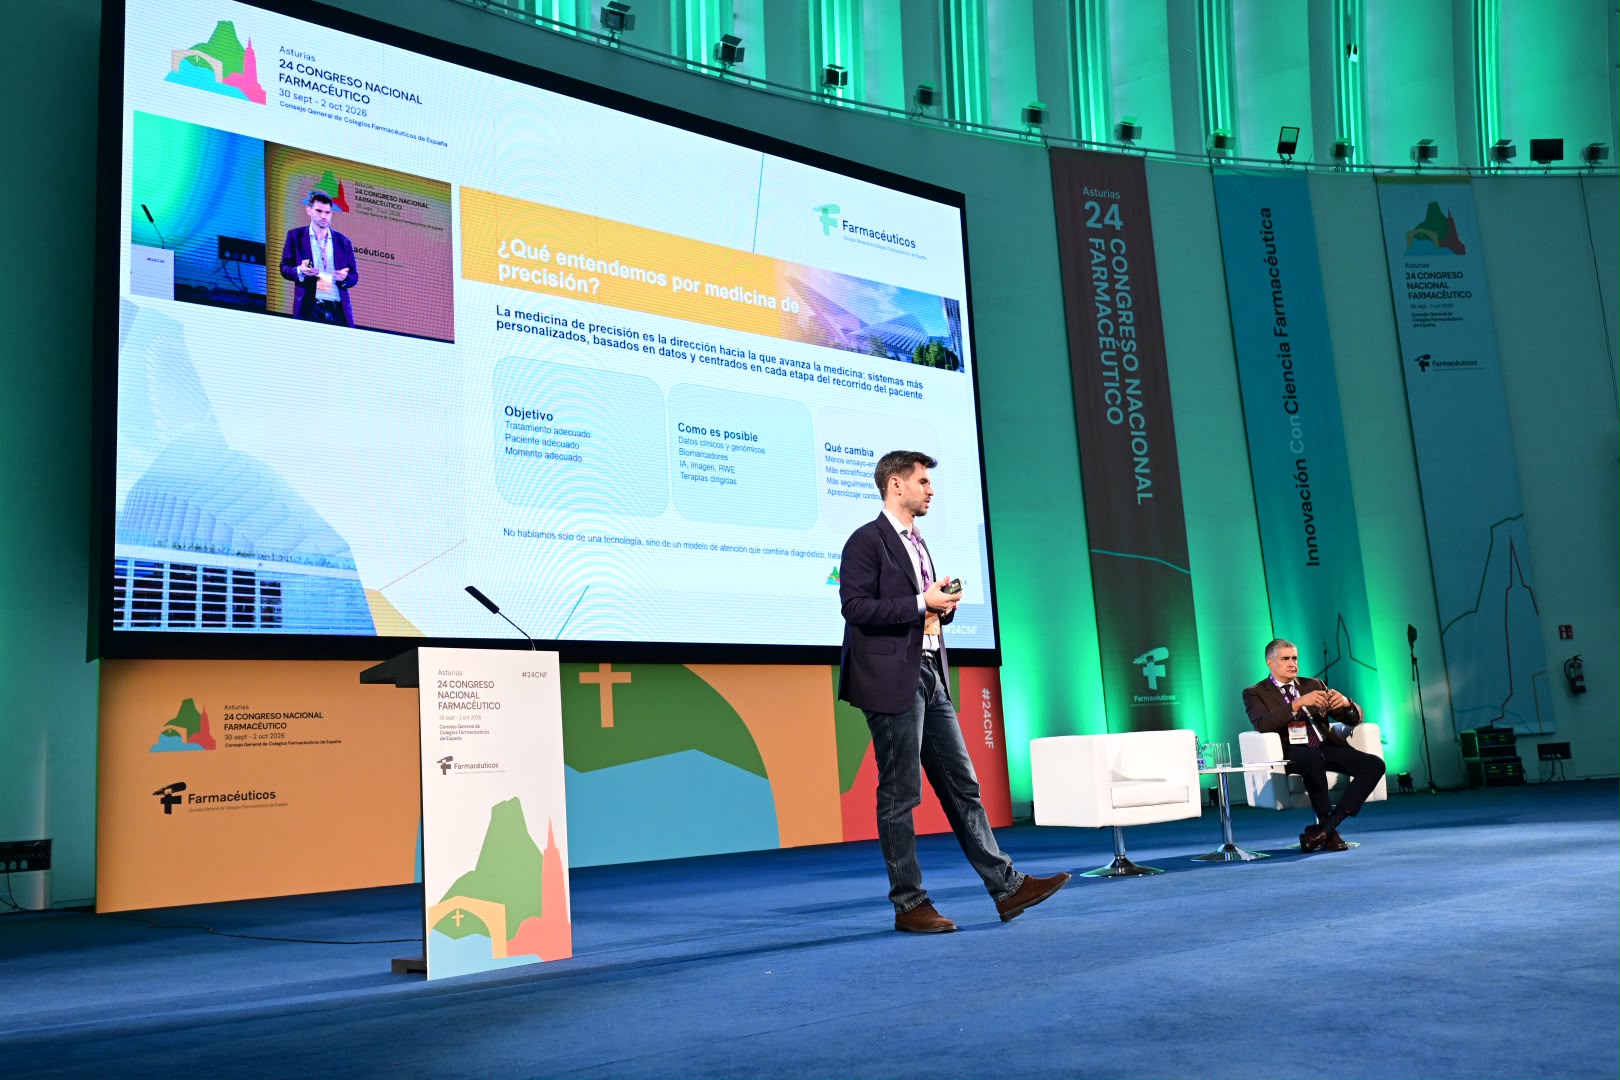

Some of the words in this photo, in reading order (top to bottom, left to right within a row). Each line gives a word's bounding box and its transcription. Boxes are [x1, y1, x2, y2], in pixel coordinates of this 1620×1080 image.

[280, 46, 316, 62] Asturias
[280, 59, 294, 70] 24
[296, 64, 362, 88] CONGRESO
[366, 82, 422, 104] NACIONAL
[280, 73, 370, 104] FARMACÉUTICO
[279, 88, 290, 98] 30
[294, 94, 312, 104] sept
[321, 98, 326, 108] 2
[328, 102, 342, 112] oct
[346, 105, 368, 117] 2026
[280, 101, 306, 112] Consejo
[308, 108, 333, 118] General
[344, 117, 371, 128] Colegios
[372, 124, 416, 140] Farmacéuticos
[426, 137, 448, 148] España
[364, 190, 398, 202] CONGRESO
[398, 197, 430, 209] NACIONAL
[1083, 186, 1120, 200] Asturias
[842, 220, 916, 249] Farmacéuticos
[353, 246, 396, 260] acéuticos
[498, 238, 551, 262] ¿Qué
[556, 252, 668, 287] entendemos
[672, 276, 700, 293] por
[706, 283, 776, 310] medicina
[781, 296, 800, 314] de
[499, 262, 600, 295] precisión?
[1260, 207, 1288, 338] Farmacéutica
[1406, 272, 1416, 280] 24
[1417, 272, 1464, 280] CONGRESO
[1407, 282, 1450, 290] NACIONAL
[1408, 290, 1472, 300] FARMACÉUTICO
[1089, 238, 1124, 425] FARMACÉUTICO
[496, 304, 511, 318] La
[514, 310, 568, 327] medicina
[572, 319, 585, 330] de
[589, 323, 640, 340] precisión
[642, 332, 655, 342] es
[658, 334, 666, 344] la
[670, 336, 716, 353] dirección
[720, 345, 746, 358] hacia
[748, 350, 756, 360] la
[760, 354, 776, 364] que
[780, 357, 811, 370] avanza
[814, 362, 821, 372] la
[824, 365, 866, 380] medicina:
[868, 372, 904, 386] sistemas
[906, 380, 924, 390] más
[1084, 200, 1124, 230] 24
[1110, 238, 1139, 372] CONGRESO
[1125, 378, 1153, 505] NACIONAL
[496, 320, 590, 345] personalizados,
[594, 335, 639, 352] basados
[642, 345, 656, 354] en
[658, 347, 688, 360] datos
[690, 354, 697, 364] y
[699, 356, 748, 370] centrados
[750, 364, 762, 372] en
[765, 366, 786, 377] cada
[790, 370, 814, 382] etapa
[817, 374, 831, 384] del
[833, 378, 872, 391] recorrido
[874, 384, 887, 394] del
[888, 387, 924, 400] paciente
[504, 406, 554, 420] Objetivo
[505, 420, 552, 434] Tratamiento
[554, 428, 591, 438] adecuado
[678, 422, 706, 436] Como
[710, 428, 720, 437] es
[724, 430, 758, 442] posible
[505, 433, 540, 445] Paciente
[542, 438, 580, 450] adecuado
[678, 436, 698, 446] Datos
[731, 444, 766, 454] genómicos
[506, 447, 542, 458] Momento
[544, 452, 582, 462] adecuado
[678, 448, 728, 460] Biomarcadores
[824, 442, 842, 453] Qué
[844, 446, 874, 458] cambia
[825, 455, 844, 464] Menos
[718, 464, 736, 474] RWE
[826, 466, 838, 474] Más
[680, 472, 708, 482] Terapias
[710, 476, 738, 486] dirigidas
[826, 477, 839, 486] Más
[840, 480, 874, 490] seguimiento
[828, 488, 861, 500] Aprendizaje
[1295, 458, 1320, 566] Innovación
[504, 528, 515, 536] No
[518, 529, 556, 540] hablamos
[558, 533, 574, 541] solo
[576, 533, 586, 542] de
[604, 536, 644, 547] tecnología,
[646, 538, 660, 547] sino
[684, 542, 708, 550] modelo
[710, 543, 718, 551] de
[720, 544, 748, 553] atención
[749, 547, 761, 556] que
[762, 548, 788, 556] combina
[790, 550, 826, 560] diagnóstico,
[438, 680, 448, 688] 24
[449, 680, 495, 689] CONGRESO
[438, 691, 480, 699] NACIONAL
[438, 700, 501, 710] FARMACÉUTICO
[236, 712, 282, 720] CONGRESO
[982, 688, 994, 749] #24CNF
[224, 722, 288, 730] FARMACÉUTICO
[234, 734, 248, 742] sept
[188, 790, 276, 804] Farmacéuticos
